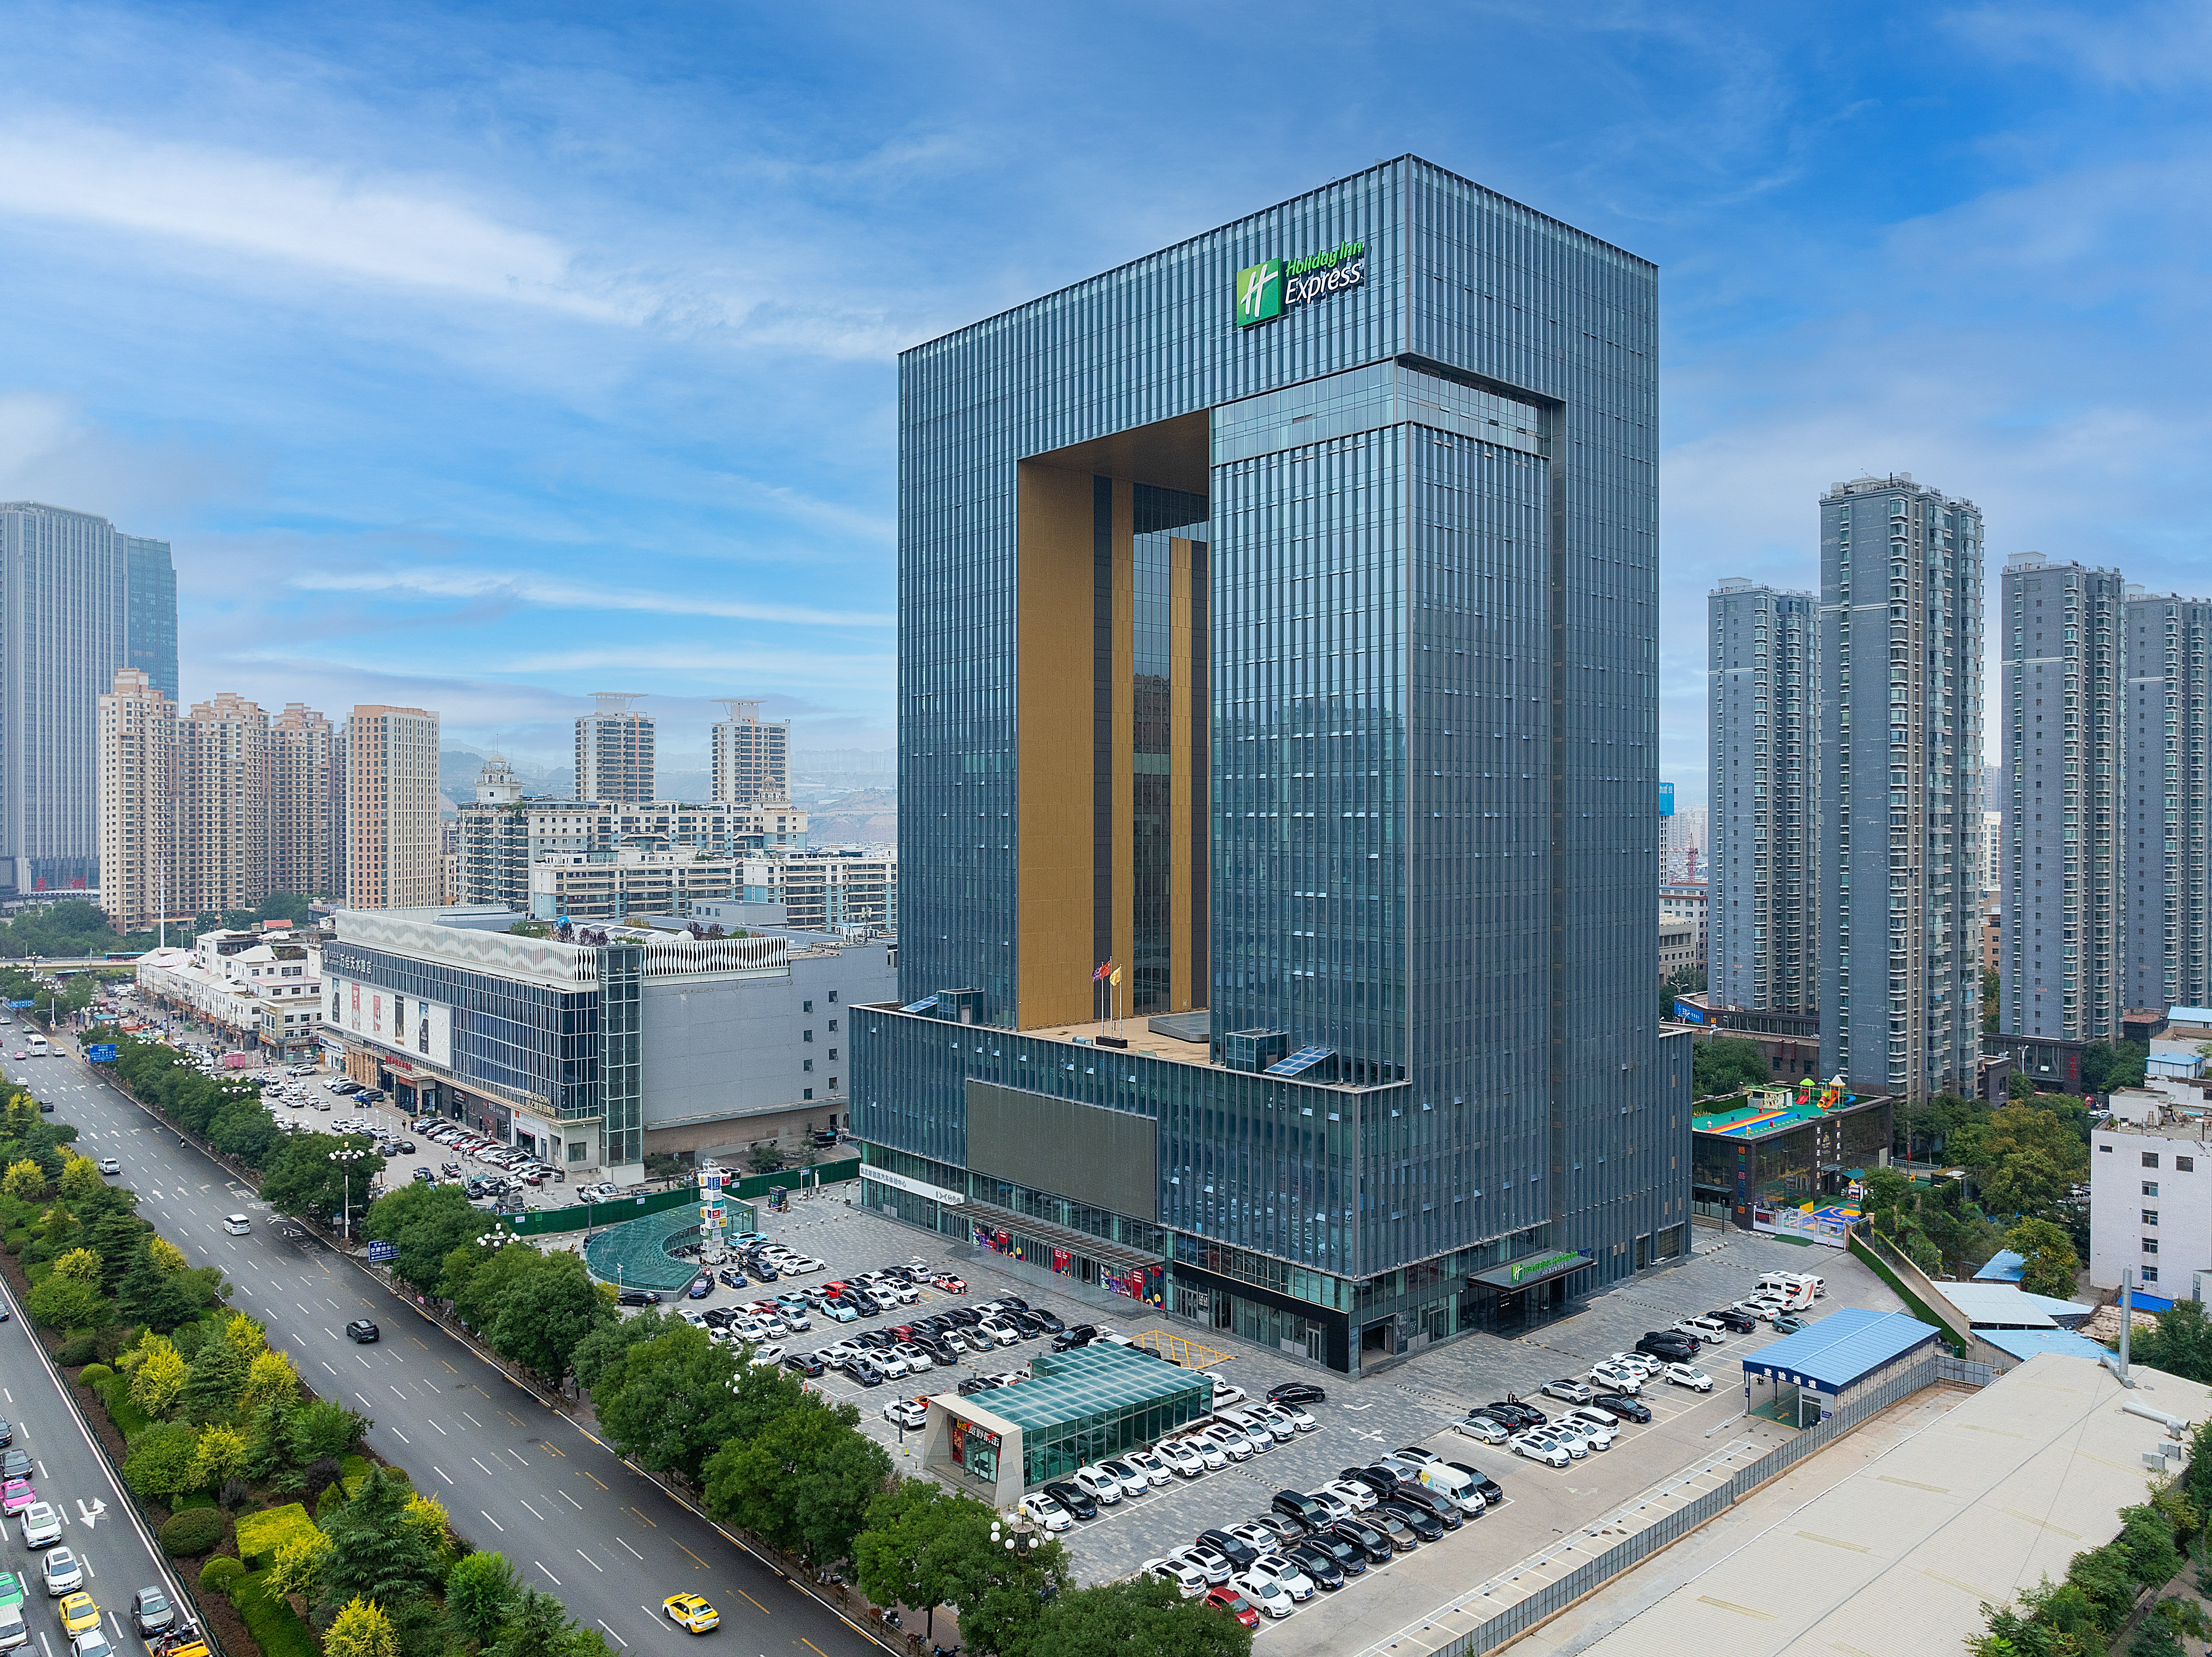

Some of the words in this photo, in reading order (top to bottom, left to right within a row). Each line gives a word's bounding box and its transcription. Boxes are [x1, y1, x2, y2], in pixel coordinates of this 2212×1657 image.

[1285, 250, 1338, 277] Holiday
[1340, 241, 1363, 260] Inn
[1285, 263, 1362, 304] Express
[1552, 1253, 1571, 1264] Holiday
[1764, 1368, 1817, 1390] 查验通道
